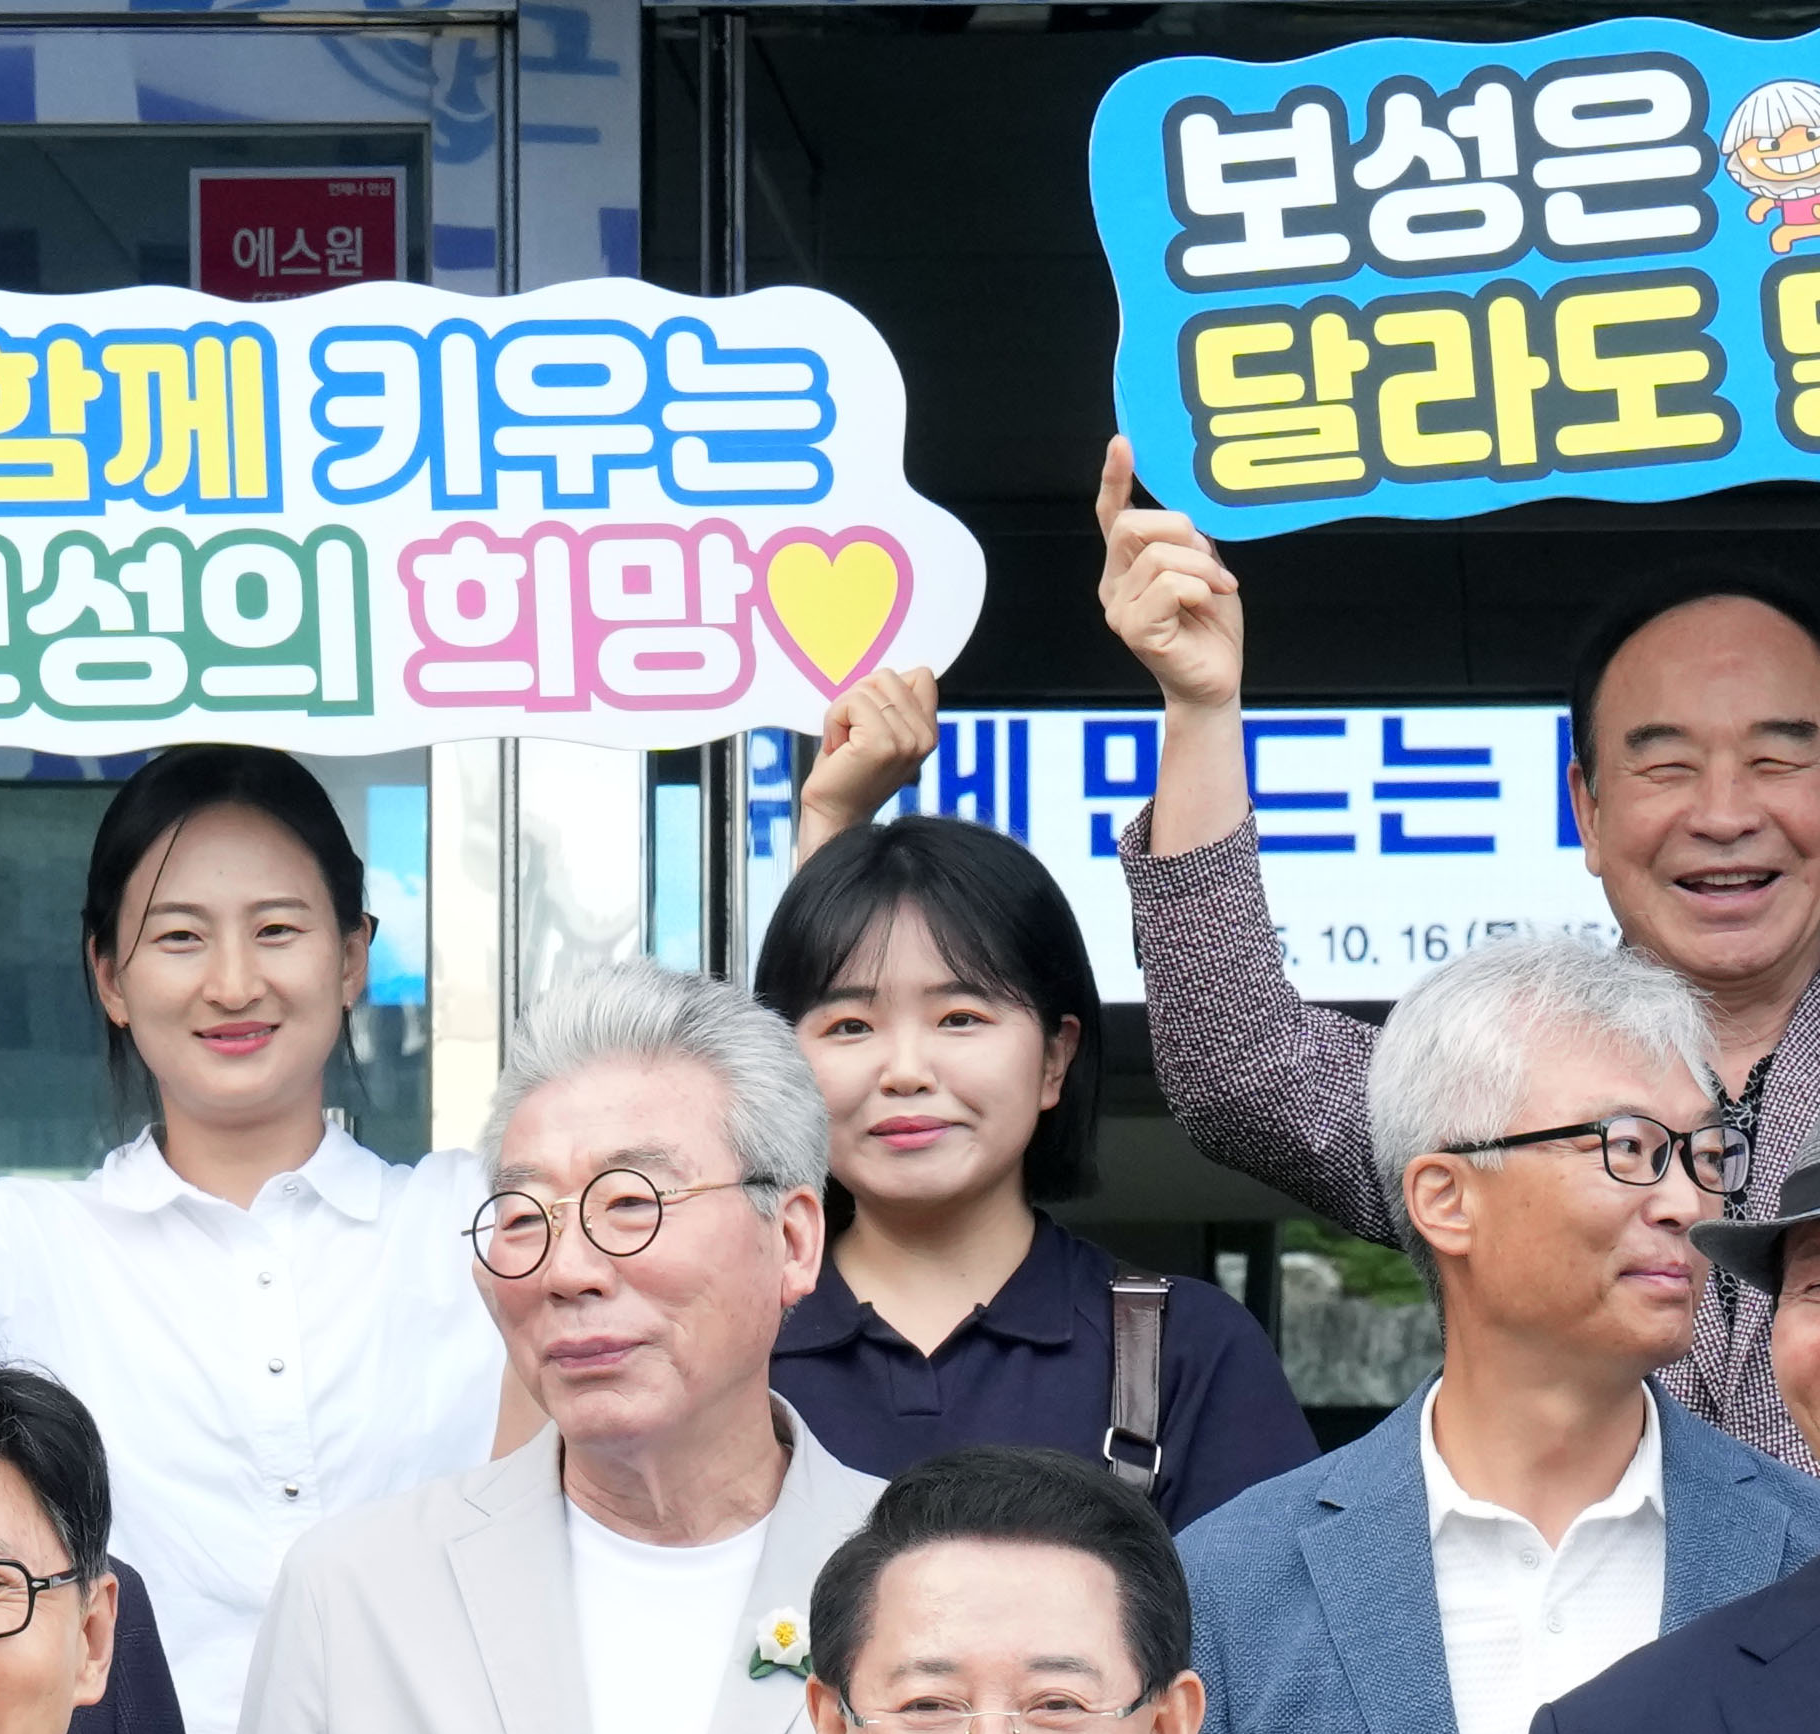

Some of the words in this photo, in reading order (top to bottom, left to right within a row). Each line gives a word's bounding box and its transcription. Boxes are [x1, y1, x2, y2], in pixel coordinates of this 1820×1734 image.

[232, 226, 364, 278] 에스원
[1168, 56, 1715, 289] 보성은
[311, 317, 836, 510] 키우는
[1186, 278, 1733, 500] 달라도
[400, 519, 755, 713] 희망
[1320, 924, 1380, 966] 10.
